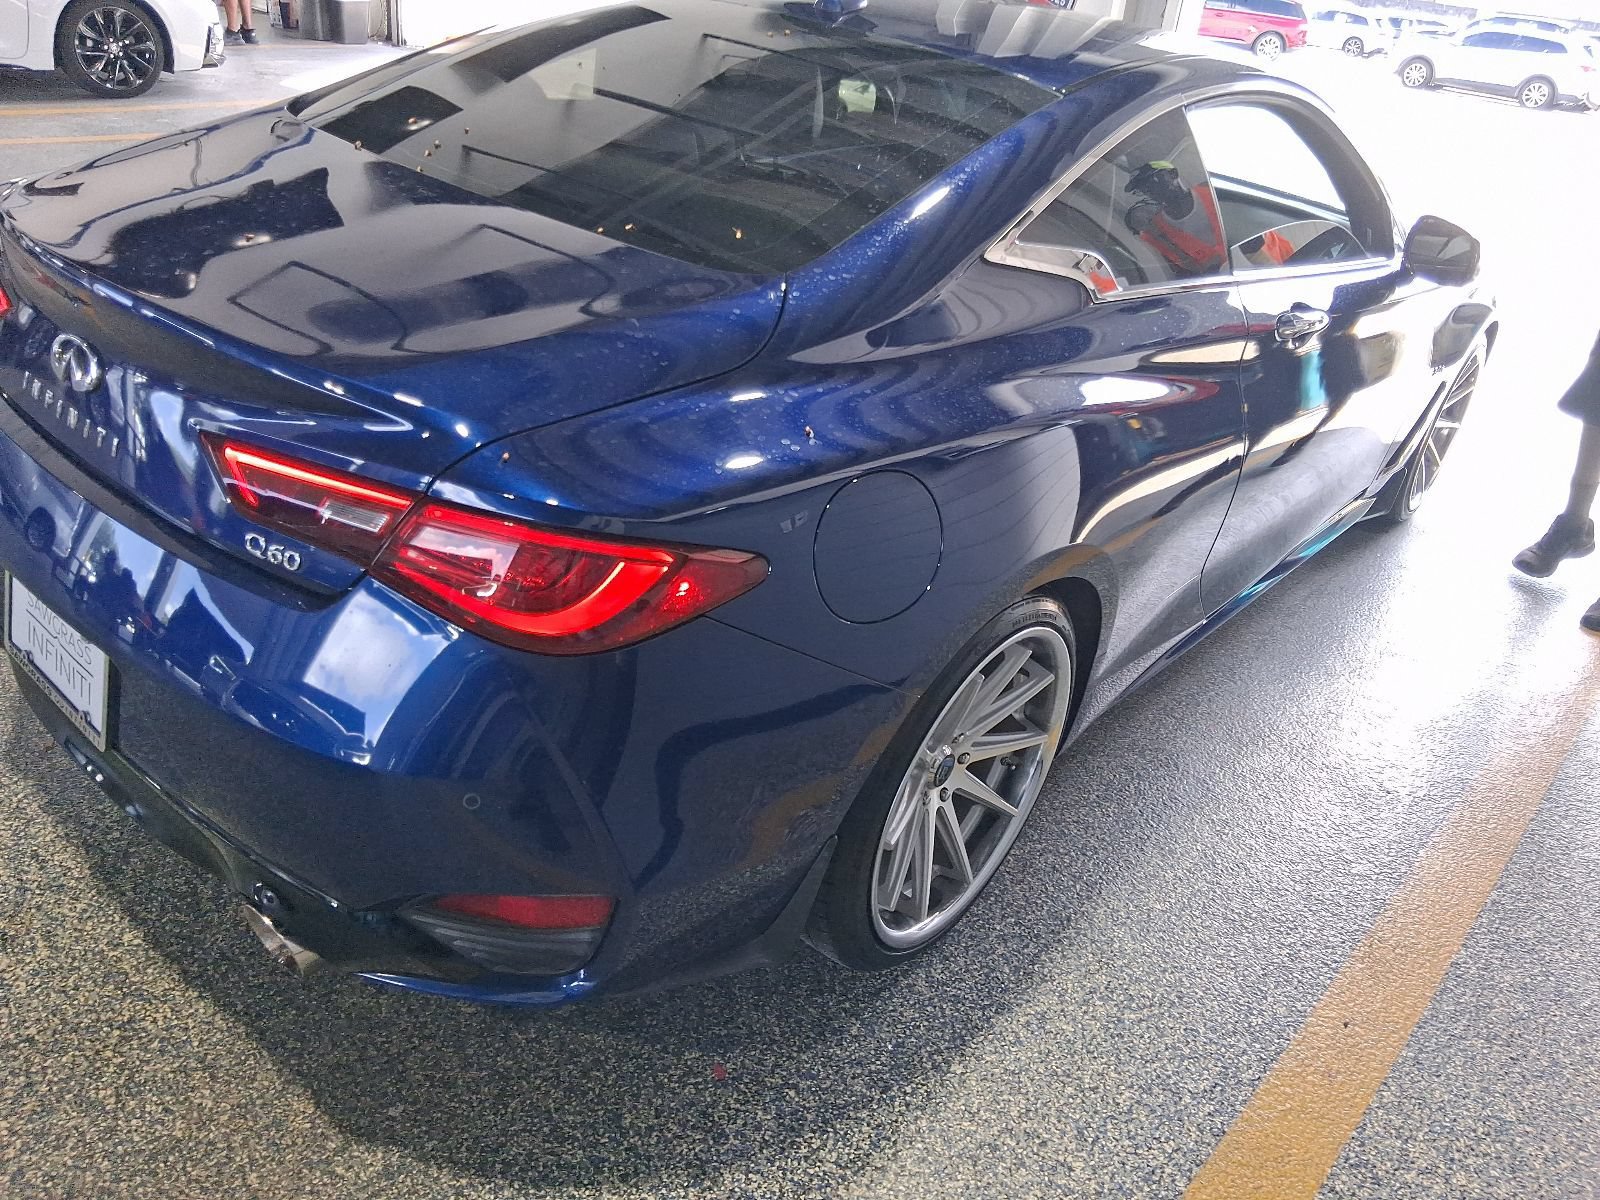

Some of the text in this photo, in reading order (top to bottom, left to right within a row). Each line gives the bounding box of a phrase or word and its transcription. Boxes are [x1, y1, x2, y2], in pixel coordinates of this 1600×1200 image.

[22, 371, 119, 457] INFINITI
[245, 533, 301, 571] Q60
[28, 620, 91, 706] INFINITI
